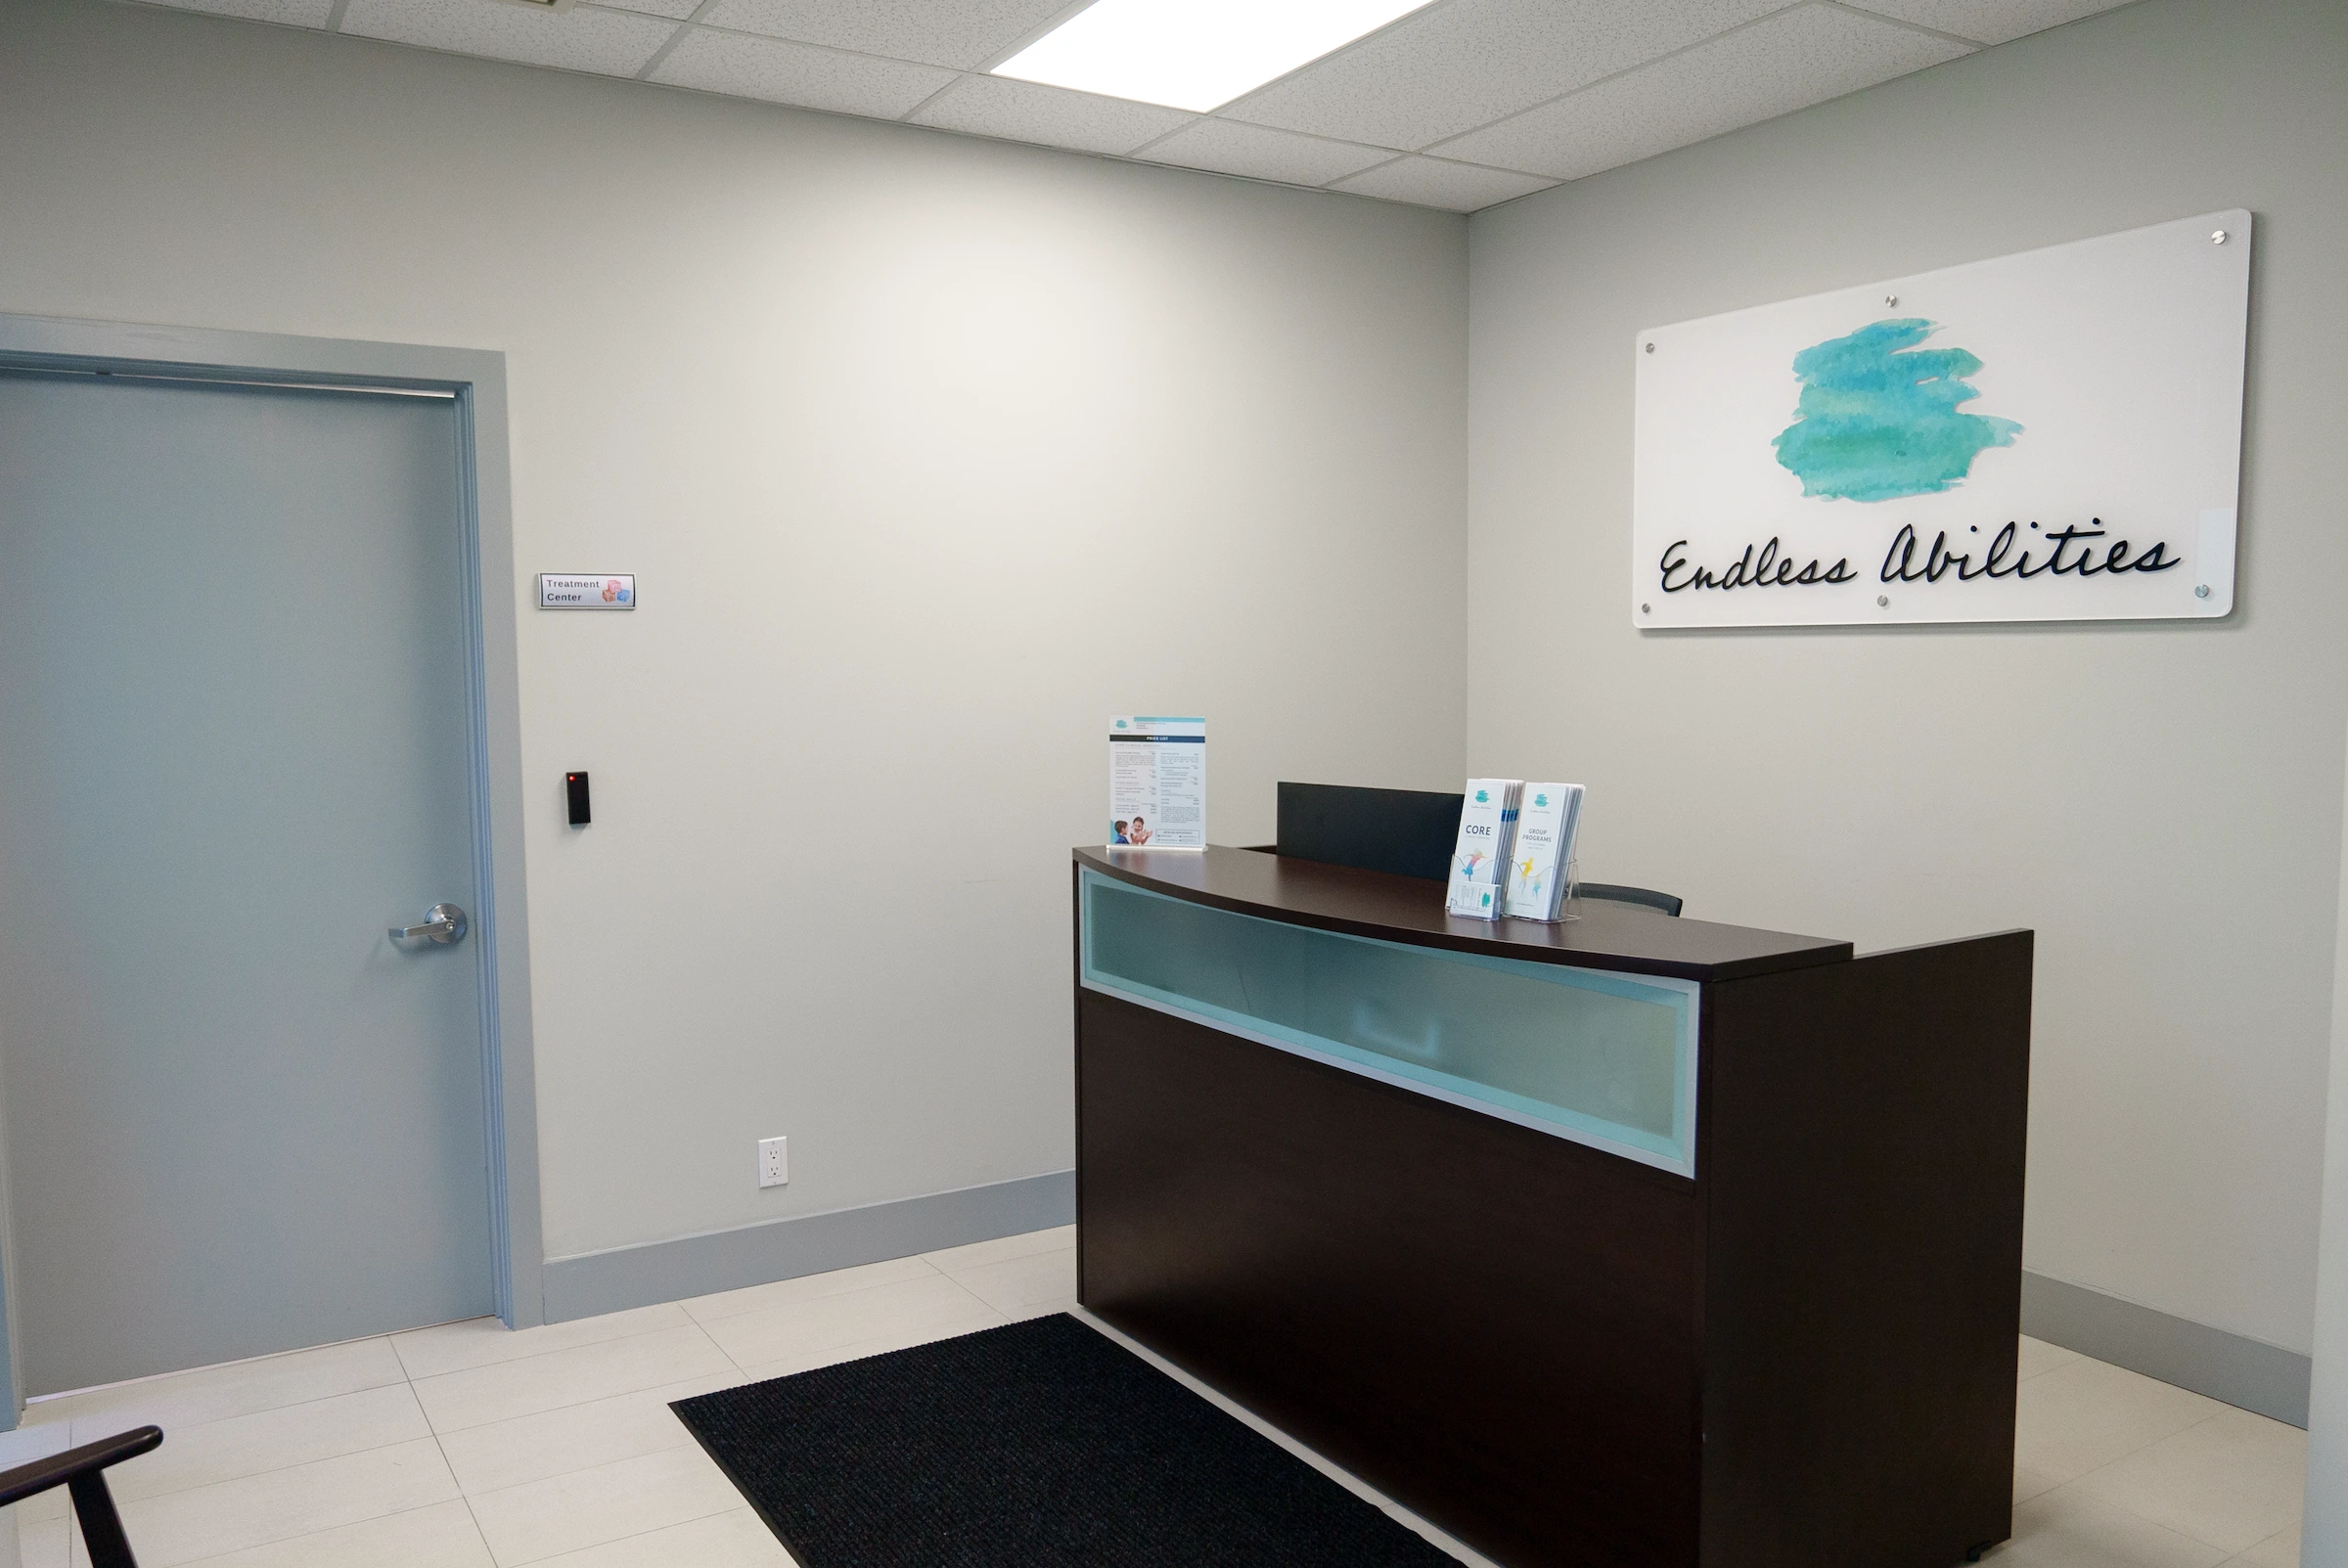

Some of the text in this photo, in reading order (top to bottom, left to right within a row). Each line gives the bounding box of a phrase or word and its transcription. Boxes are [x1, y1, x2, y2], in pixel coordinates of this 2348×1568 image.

[1661, 518, 2181, 592] Endless Abilities
[547, 579, 600, 588] Treatment
[547, 593, 582, 602] Center
[1466, 825, 1491, 835] CORE
